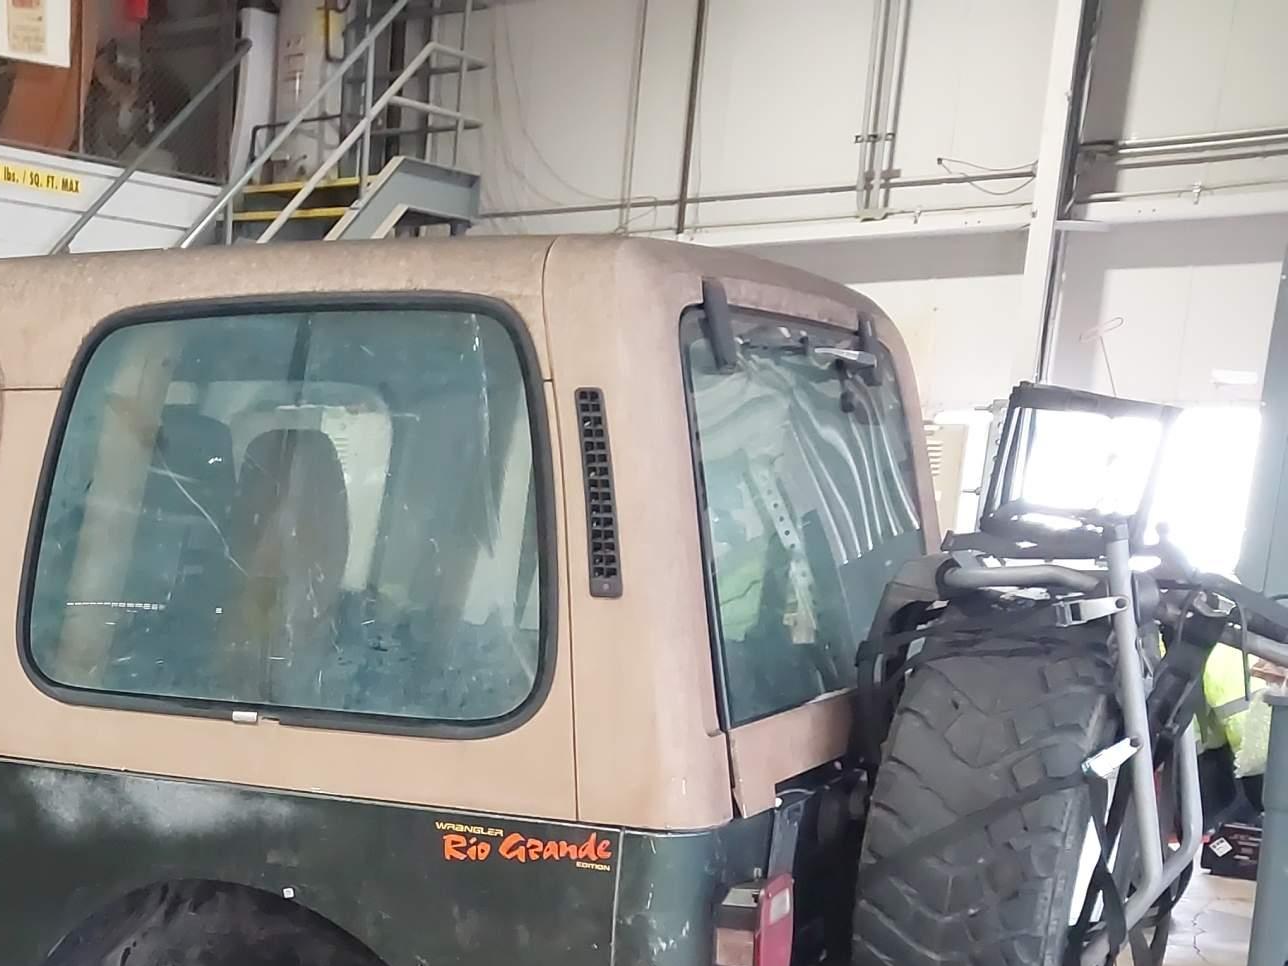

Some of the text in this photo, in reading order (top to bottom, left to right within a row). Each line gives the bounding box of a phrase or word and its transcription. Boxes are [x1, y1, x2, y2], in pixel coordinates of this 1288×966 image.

[3, 166, 19, 183] lbs.
[22, 170, 27, 184] /
[29, 171, 43, 188] SQ.
[46, 175, 58, 189] FT.
[61, 178, 80, 193] MAX
[434, 821, 505, 837] WRANGLER
[442, 832, 613, 864] Rio Grande
[575, 860, 611, 872] EDITION
